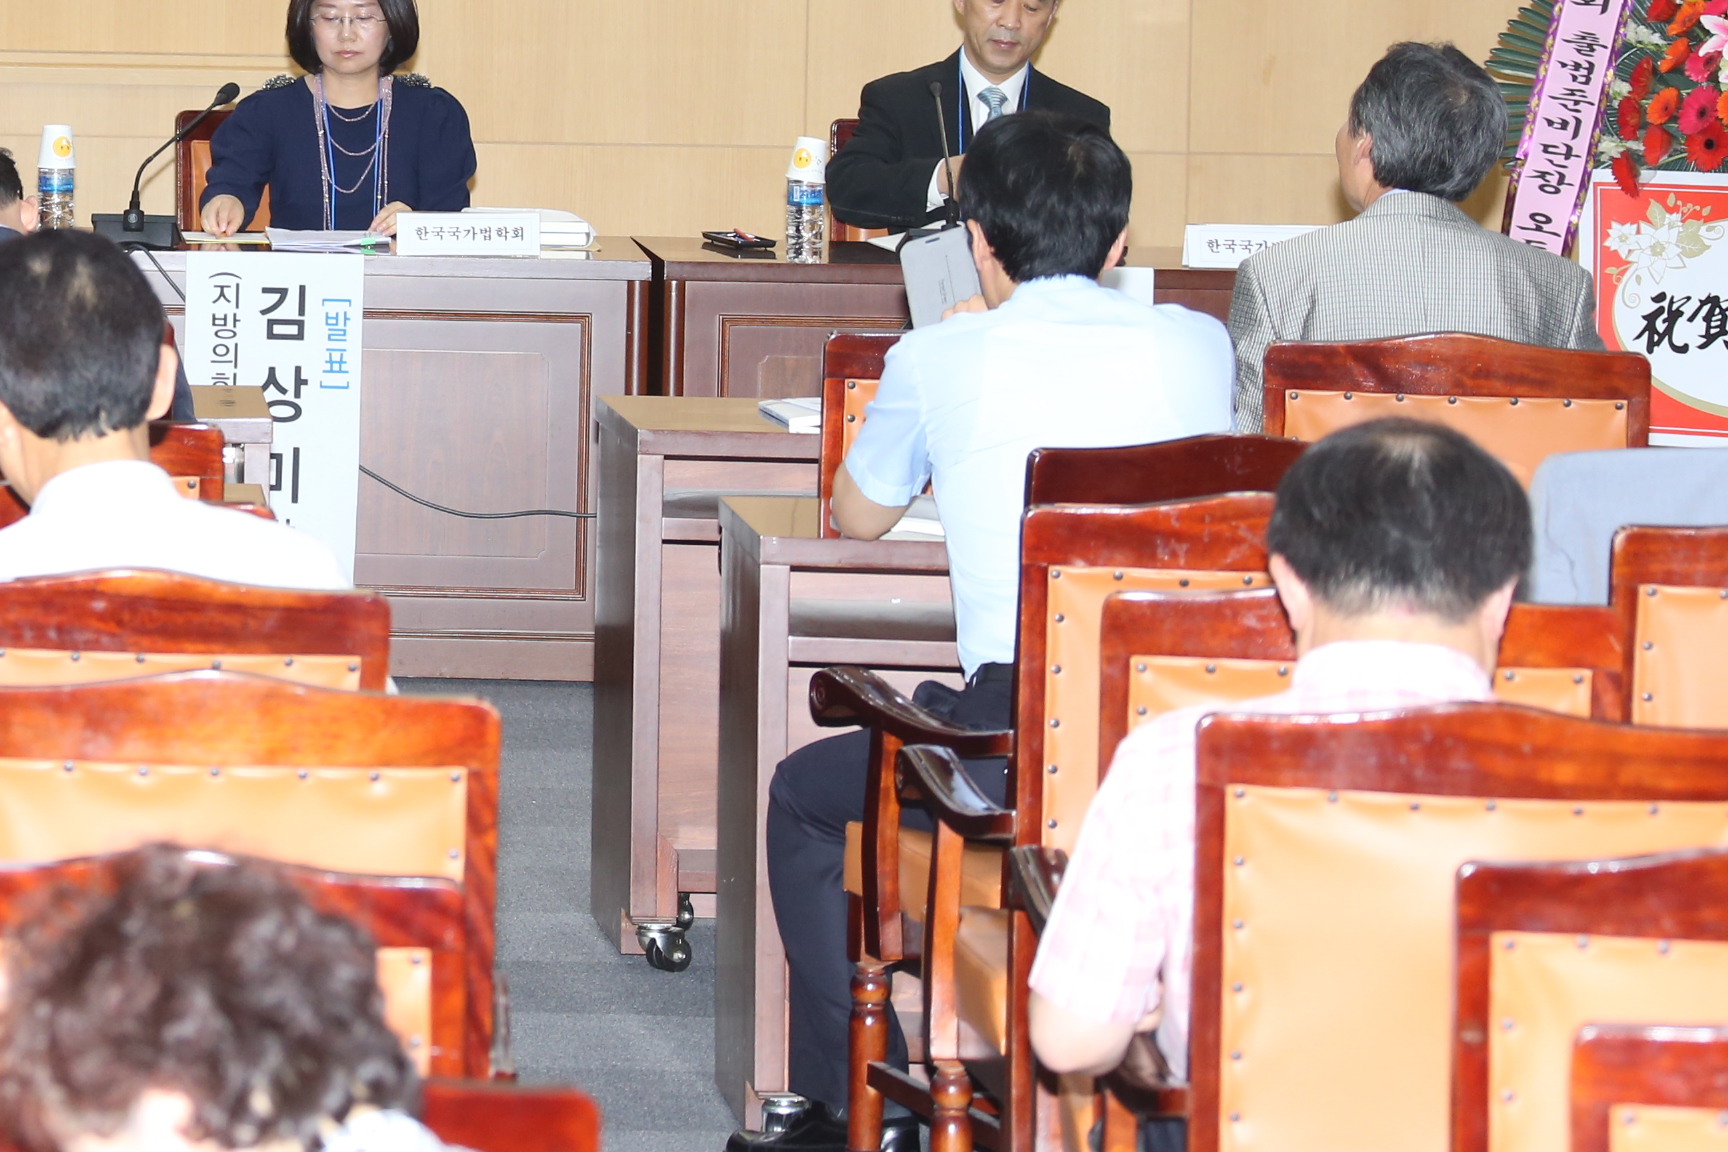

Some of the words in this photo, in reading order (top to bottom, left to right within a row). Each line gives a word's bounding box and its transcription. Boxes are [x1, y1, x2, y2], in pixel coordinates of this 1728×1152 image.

[1525, 30, 1609, 195] 출범준비단장
[415, 226, 524, 242] 한국국가법학회
[319, 298, 353, 390] [발표]
